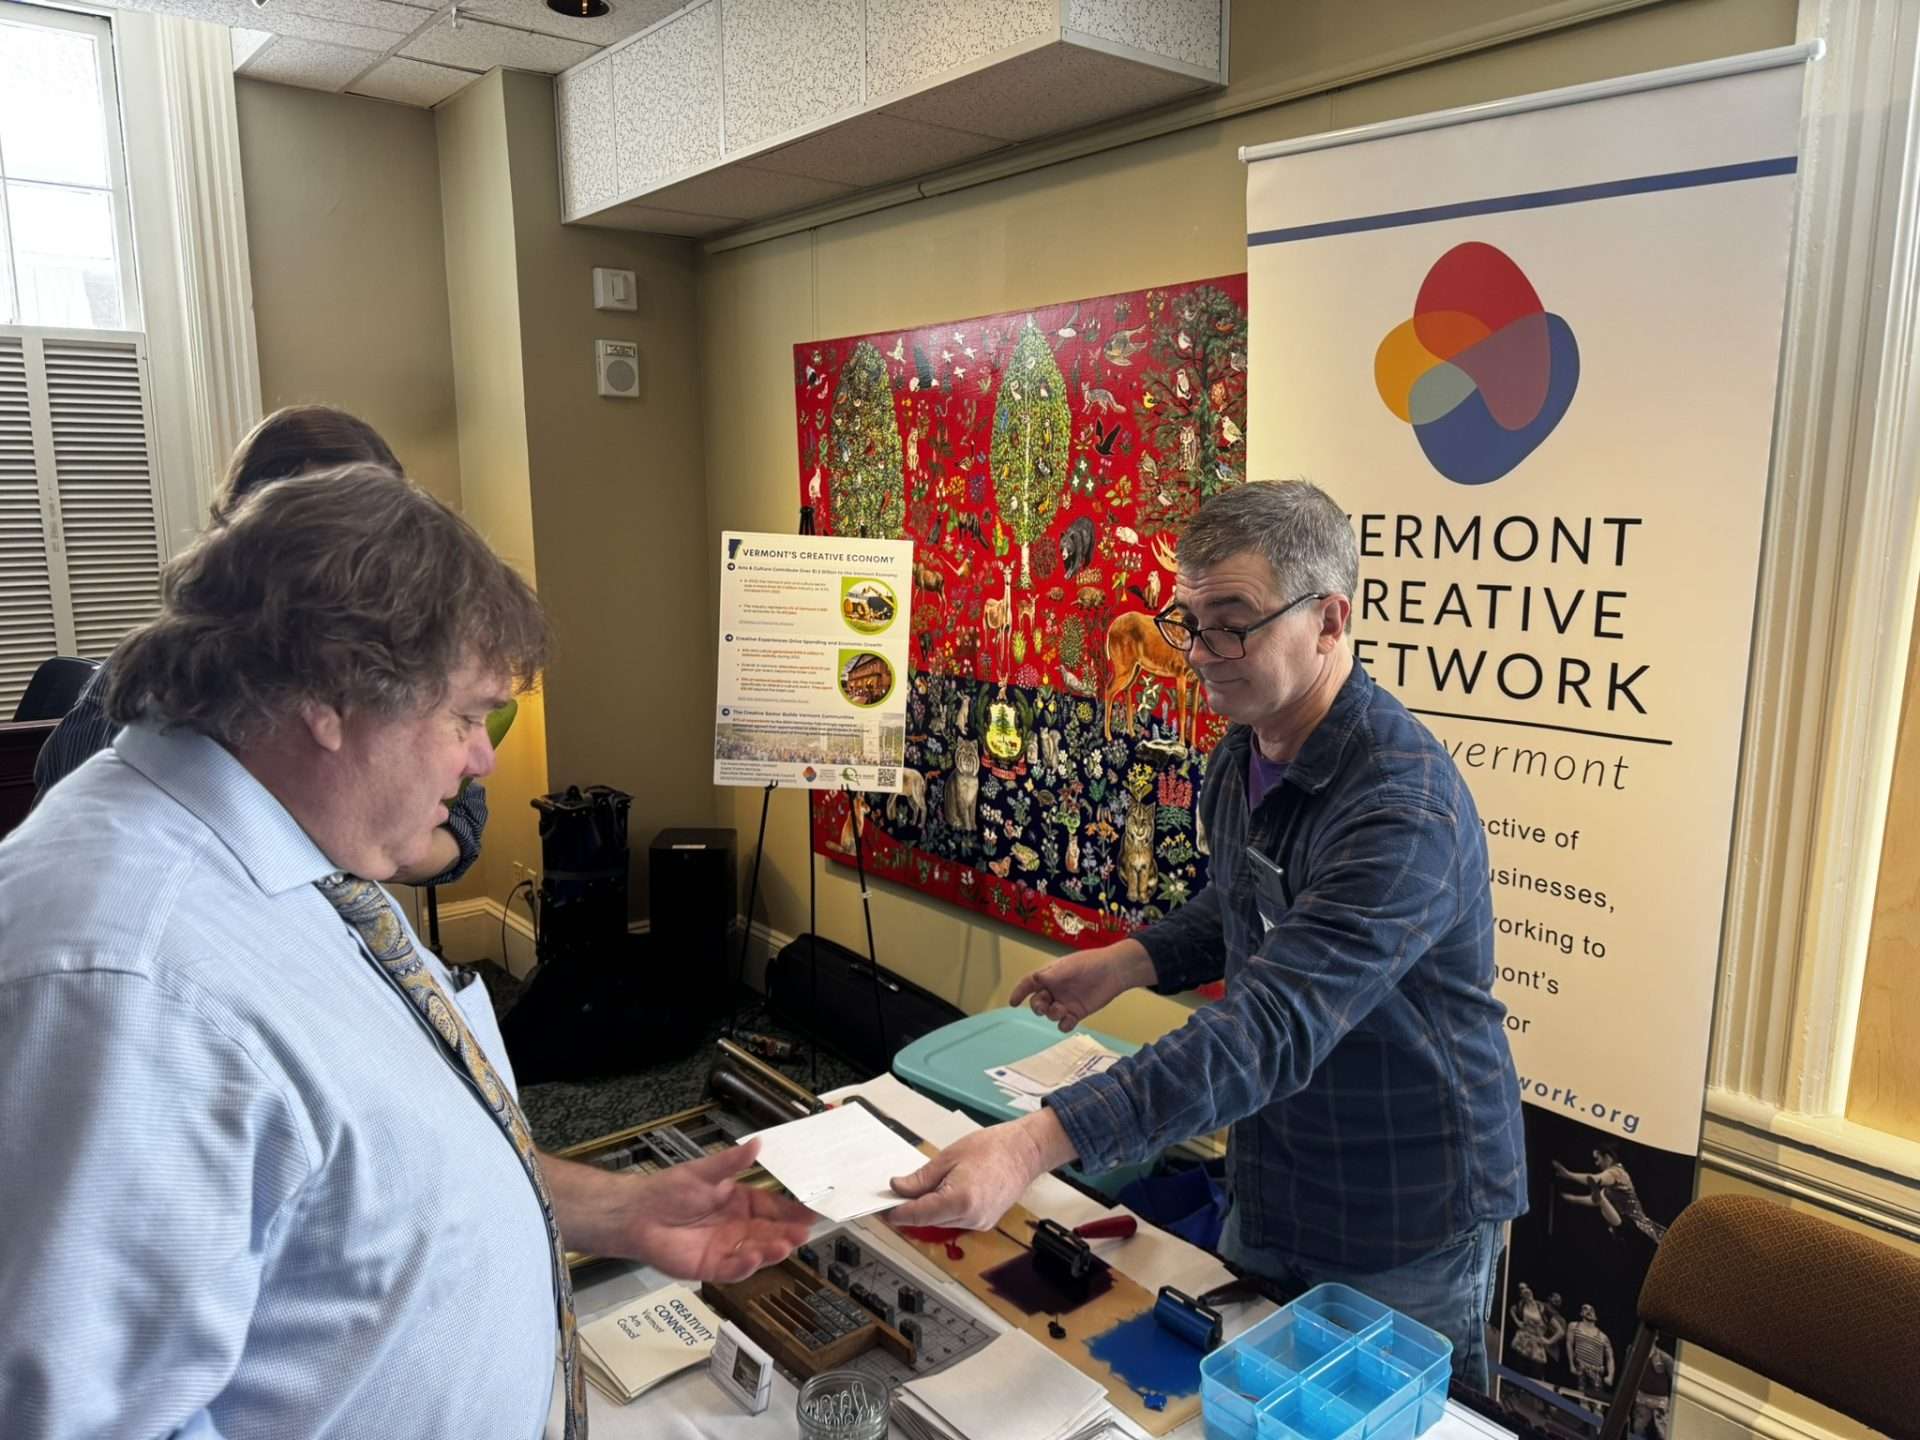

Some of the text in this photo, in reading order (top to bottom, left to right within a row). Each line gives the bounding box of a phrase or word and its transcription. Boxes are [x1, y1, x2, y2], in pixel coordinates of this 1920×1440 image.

[742, 549, 895, 564] VERMONT'S CREATIVE ECONOMY
[1347, 514, 1642, 566] ERMONT
[1362, 578, 1627, 639] REATIVE
[1354, 639, 1651, 715] ETWORK
[1555, 829, 1580, 851] of
[1494, 917, 1606, 958] orking to
[1519, 1076, 1640, 1133] work.org
[654, 1304, 698, 1346] CONNECTS
[669, 1299, 715, 1341] CREATIVITY
